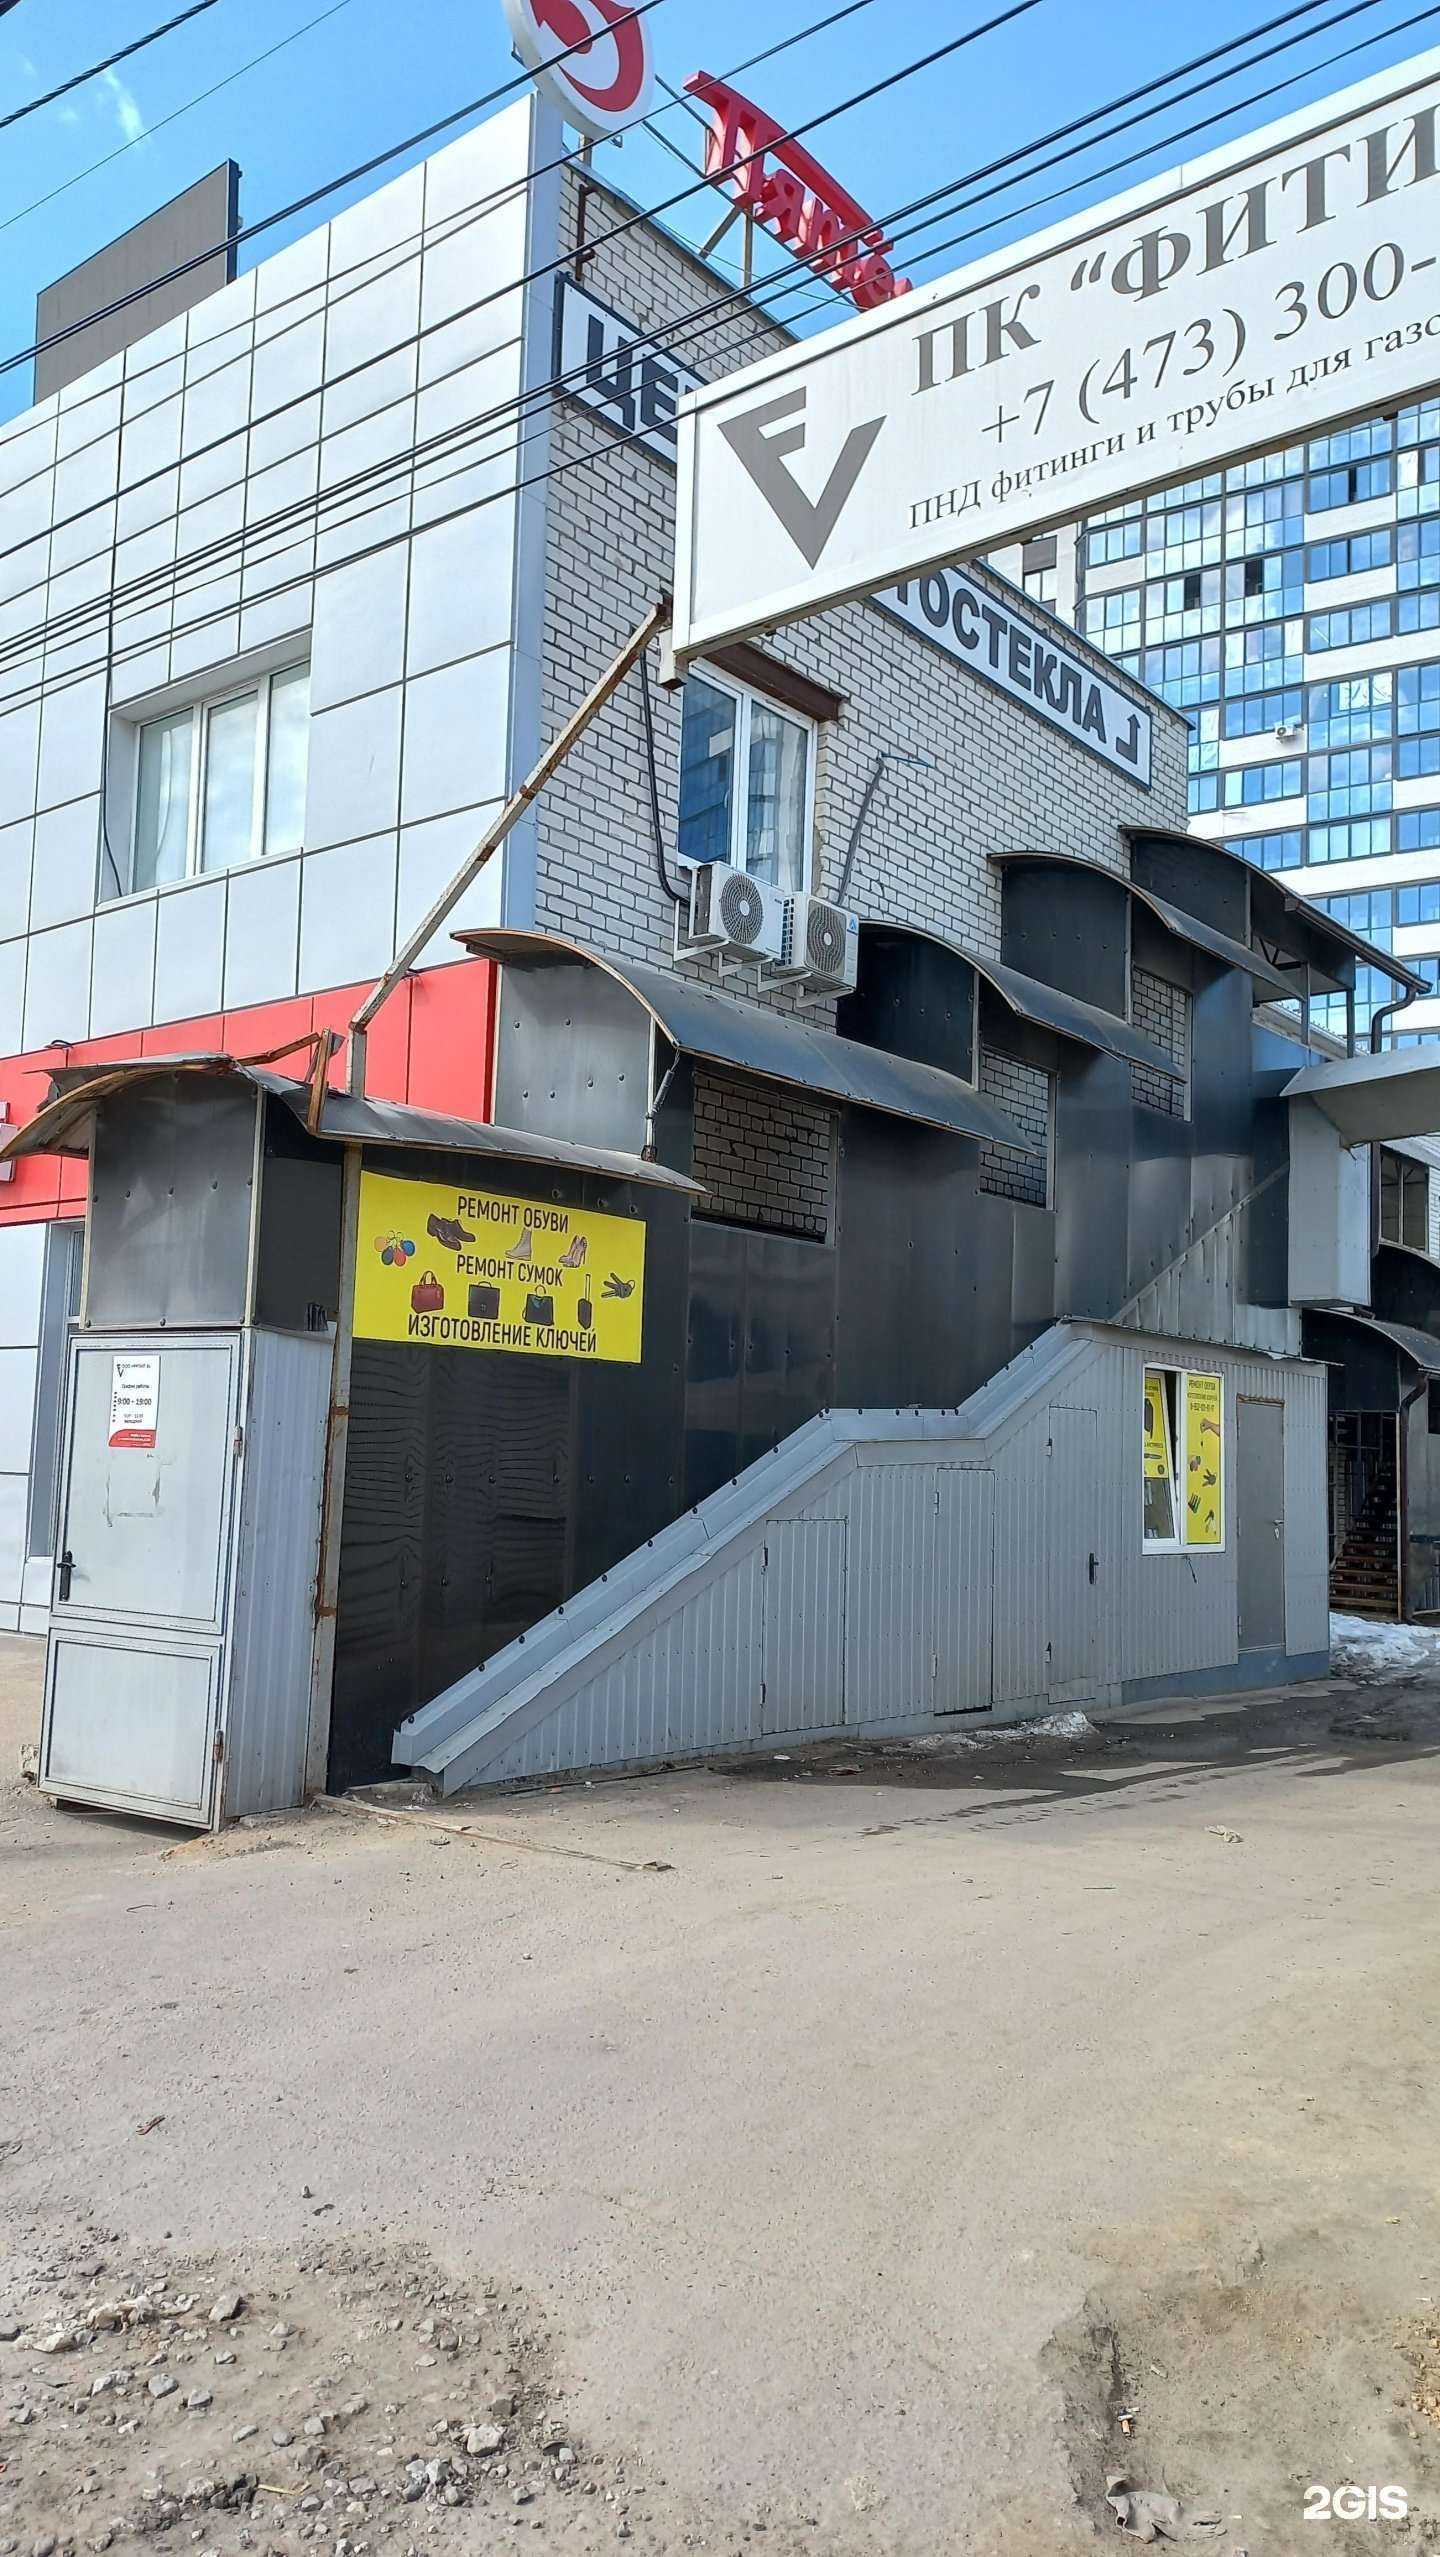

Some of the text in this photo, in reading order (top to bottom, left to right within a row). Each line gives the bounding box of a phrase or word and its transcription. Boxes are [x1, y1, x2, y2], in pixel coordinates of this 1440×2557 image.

[910, 283, 1042, 396] ПК
[981, 242, 1437, 443] +7 (473) 300-
[908, 479, 983, 530] ПНД
[990, 429, 1125, 504] фитинги
[1134, 420, 1156, 446] и
[1166, 373, 1275, 439] трубы
[1286, 346, 1352, 393] для
[586, 313, 1107, 744] ЦЕ ОСТЕКЛА
[456, 1254, 563, 1287] РЕМОНТ СУМОК
[457, 1195, 569, 1234] РЕМОНТ ОБУВИ
[408, 1314, 597, 1353] ИЗГОТОВЛЕНИЕ КЛЮЧЕЙ
